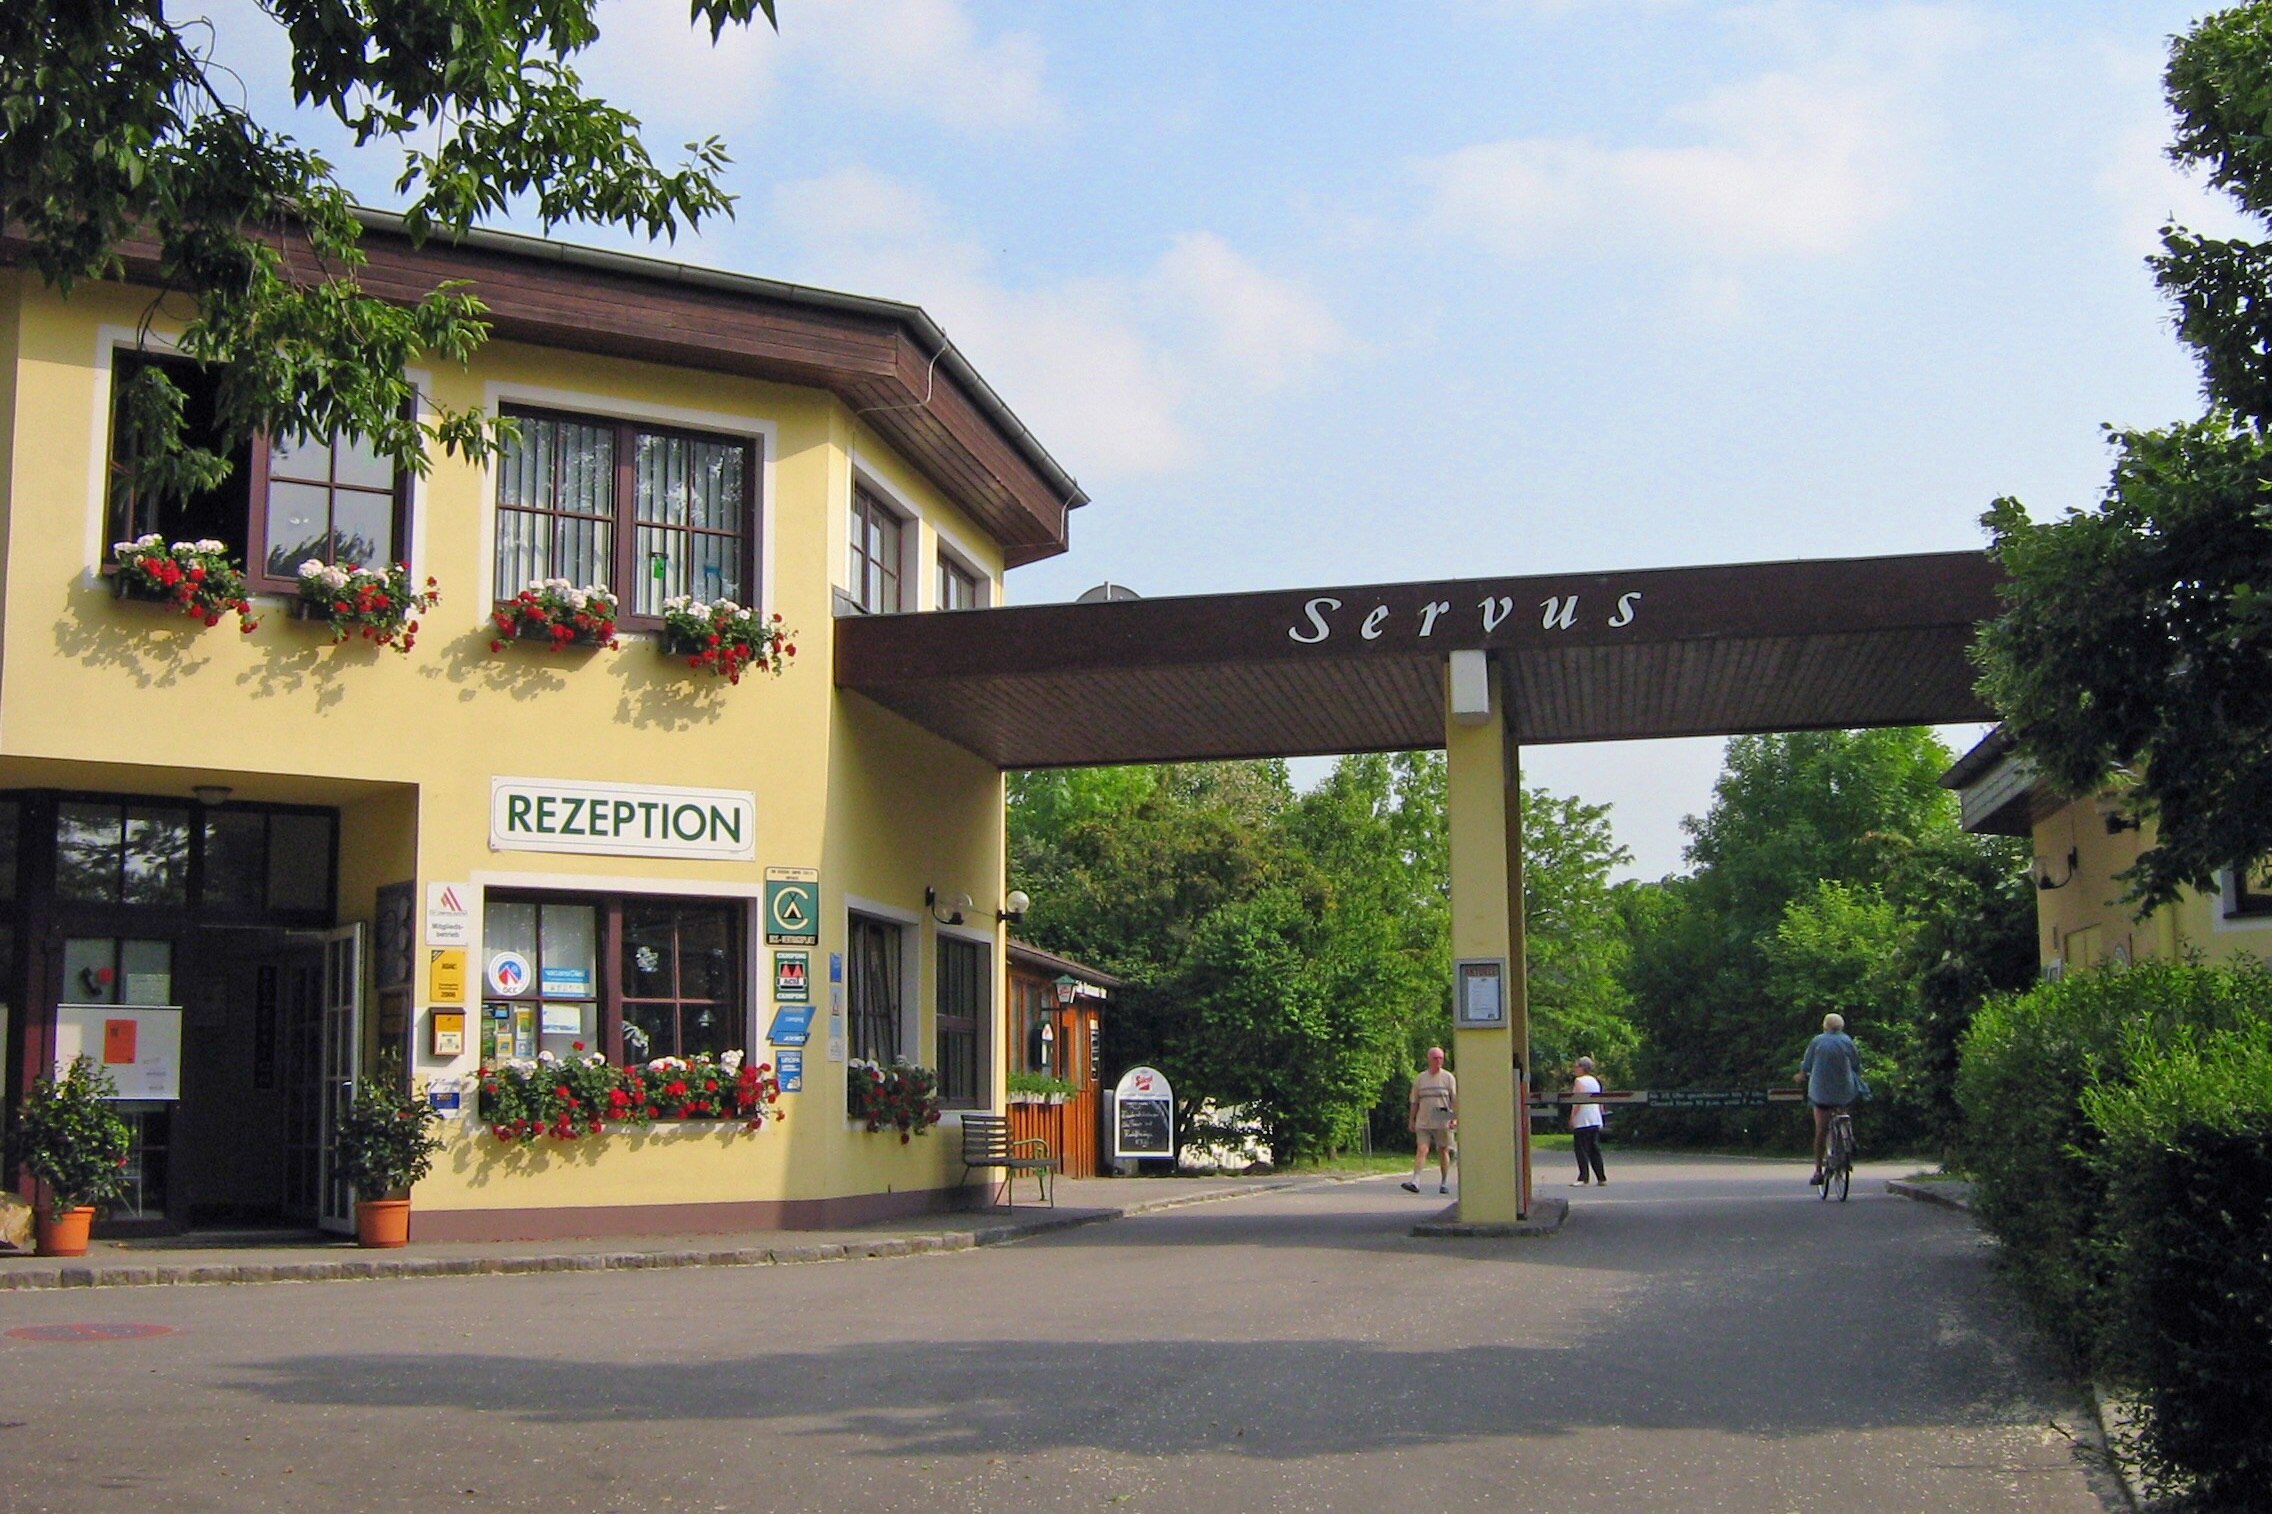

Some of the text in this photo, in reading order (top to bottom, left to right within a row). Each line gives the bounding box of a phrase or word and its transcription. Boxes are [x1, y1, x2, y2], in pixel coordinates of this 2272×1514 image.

[1288, 591, 1642, 644] Servus
[508, 794, 741, 844] REZEPTION
[776, 952, 807, 960] CAMPING
[776, 992, 807, 1000] CAMPING
